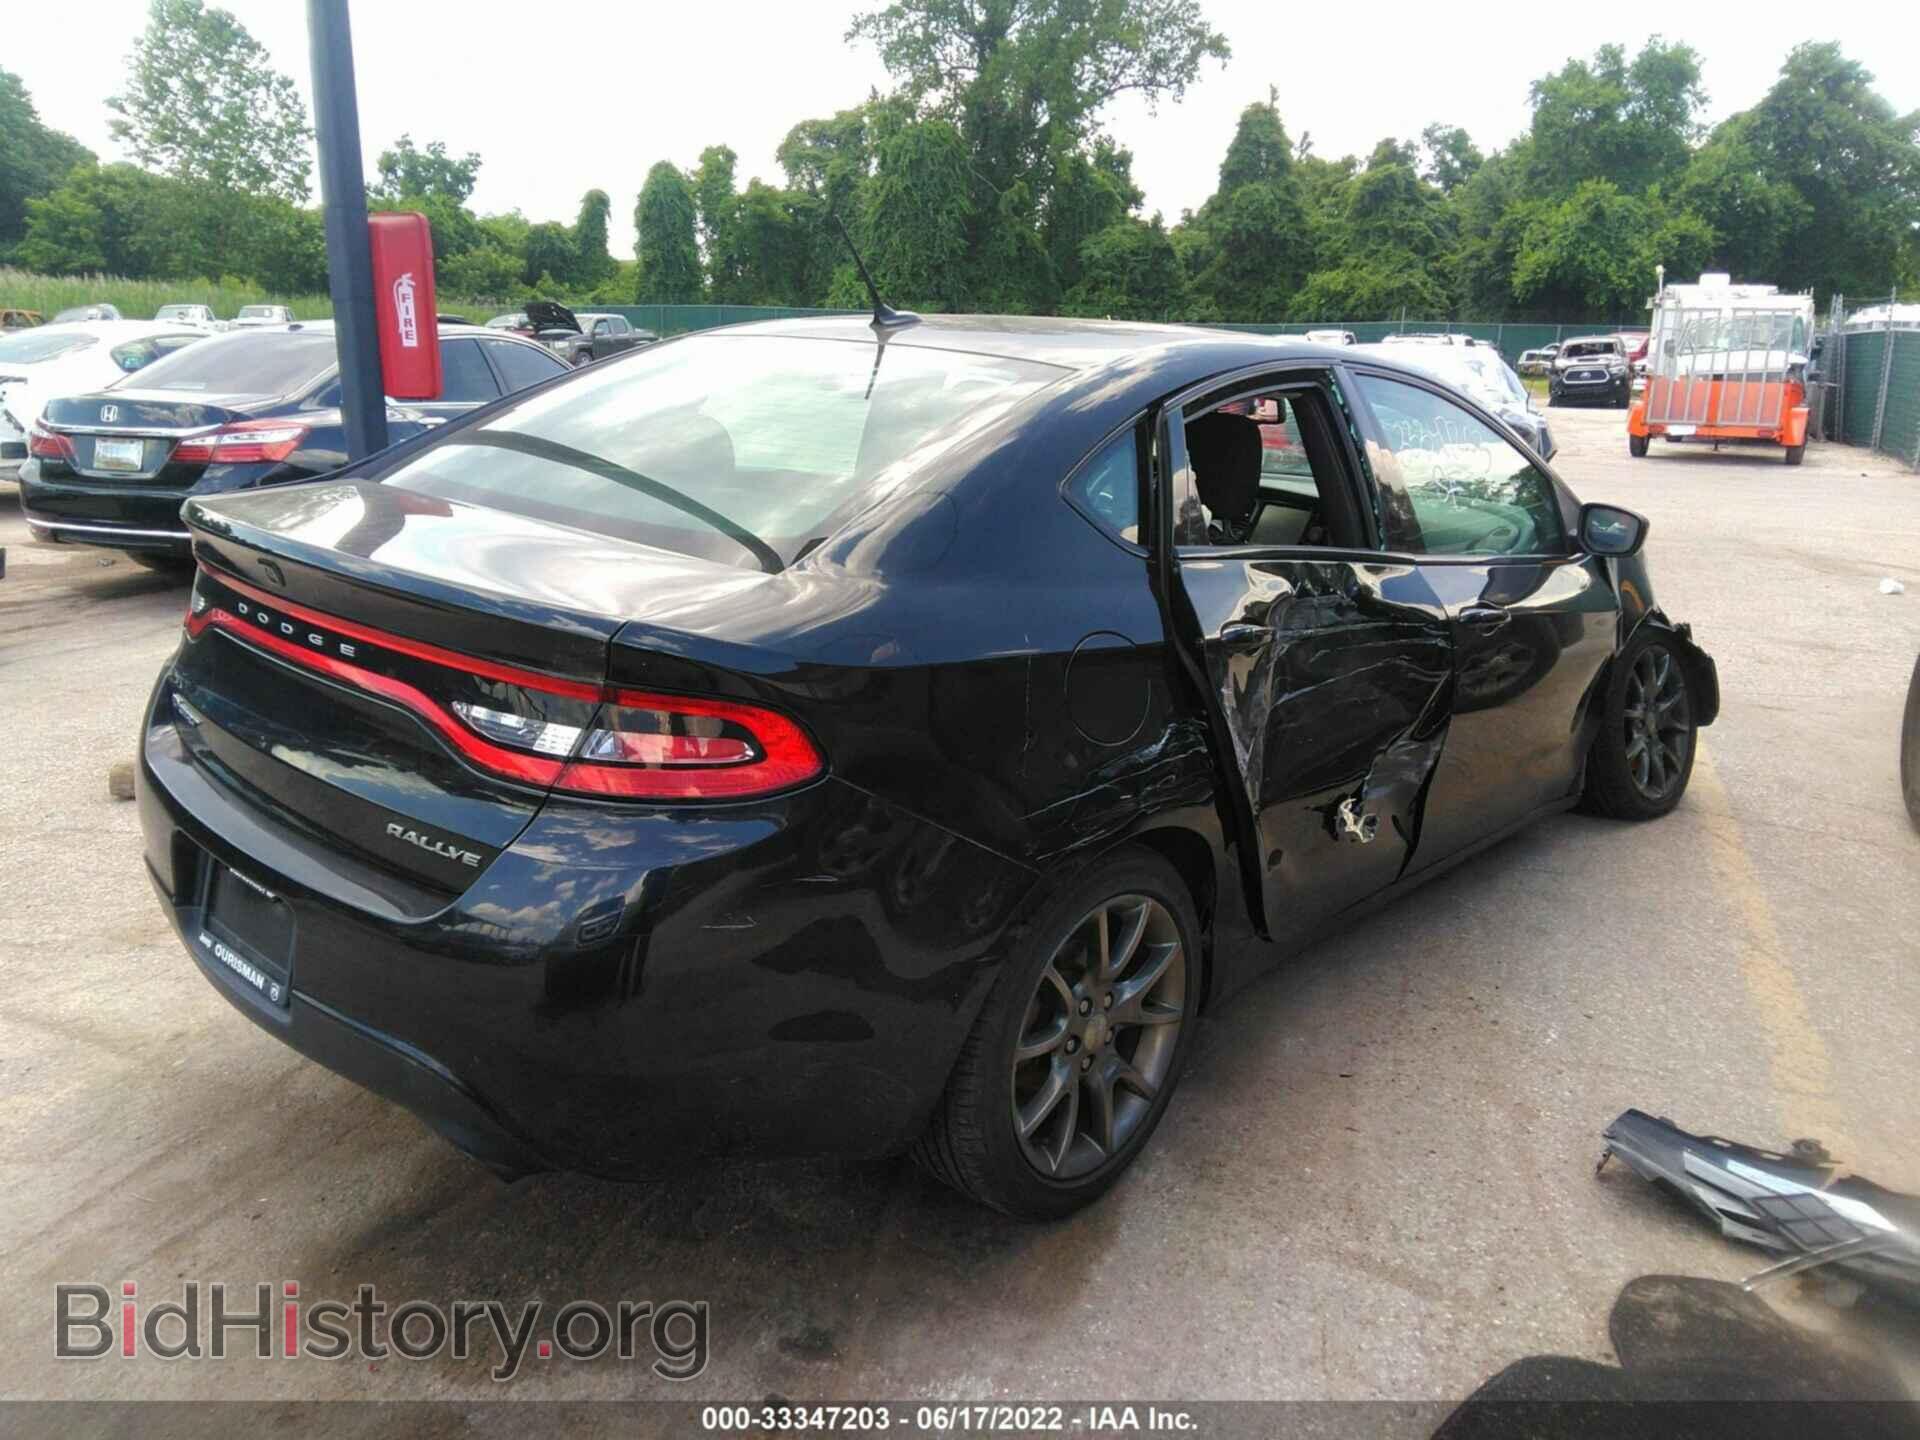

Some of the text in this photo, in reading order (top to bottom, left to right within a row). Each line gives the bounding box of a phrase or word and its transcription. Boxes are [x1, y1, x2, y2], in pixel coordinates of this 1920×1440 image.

[401, 293, 415, 340] FIRE
[238, 602, 356, 657] DODGE
[386, 823, 482, 868] RALLYE
[214, 943, 265, 990] OURISMAN
